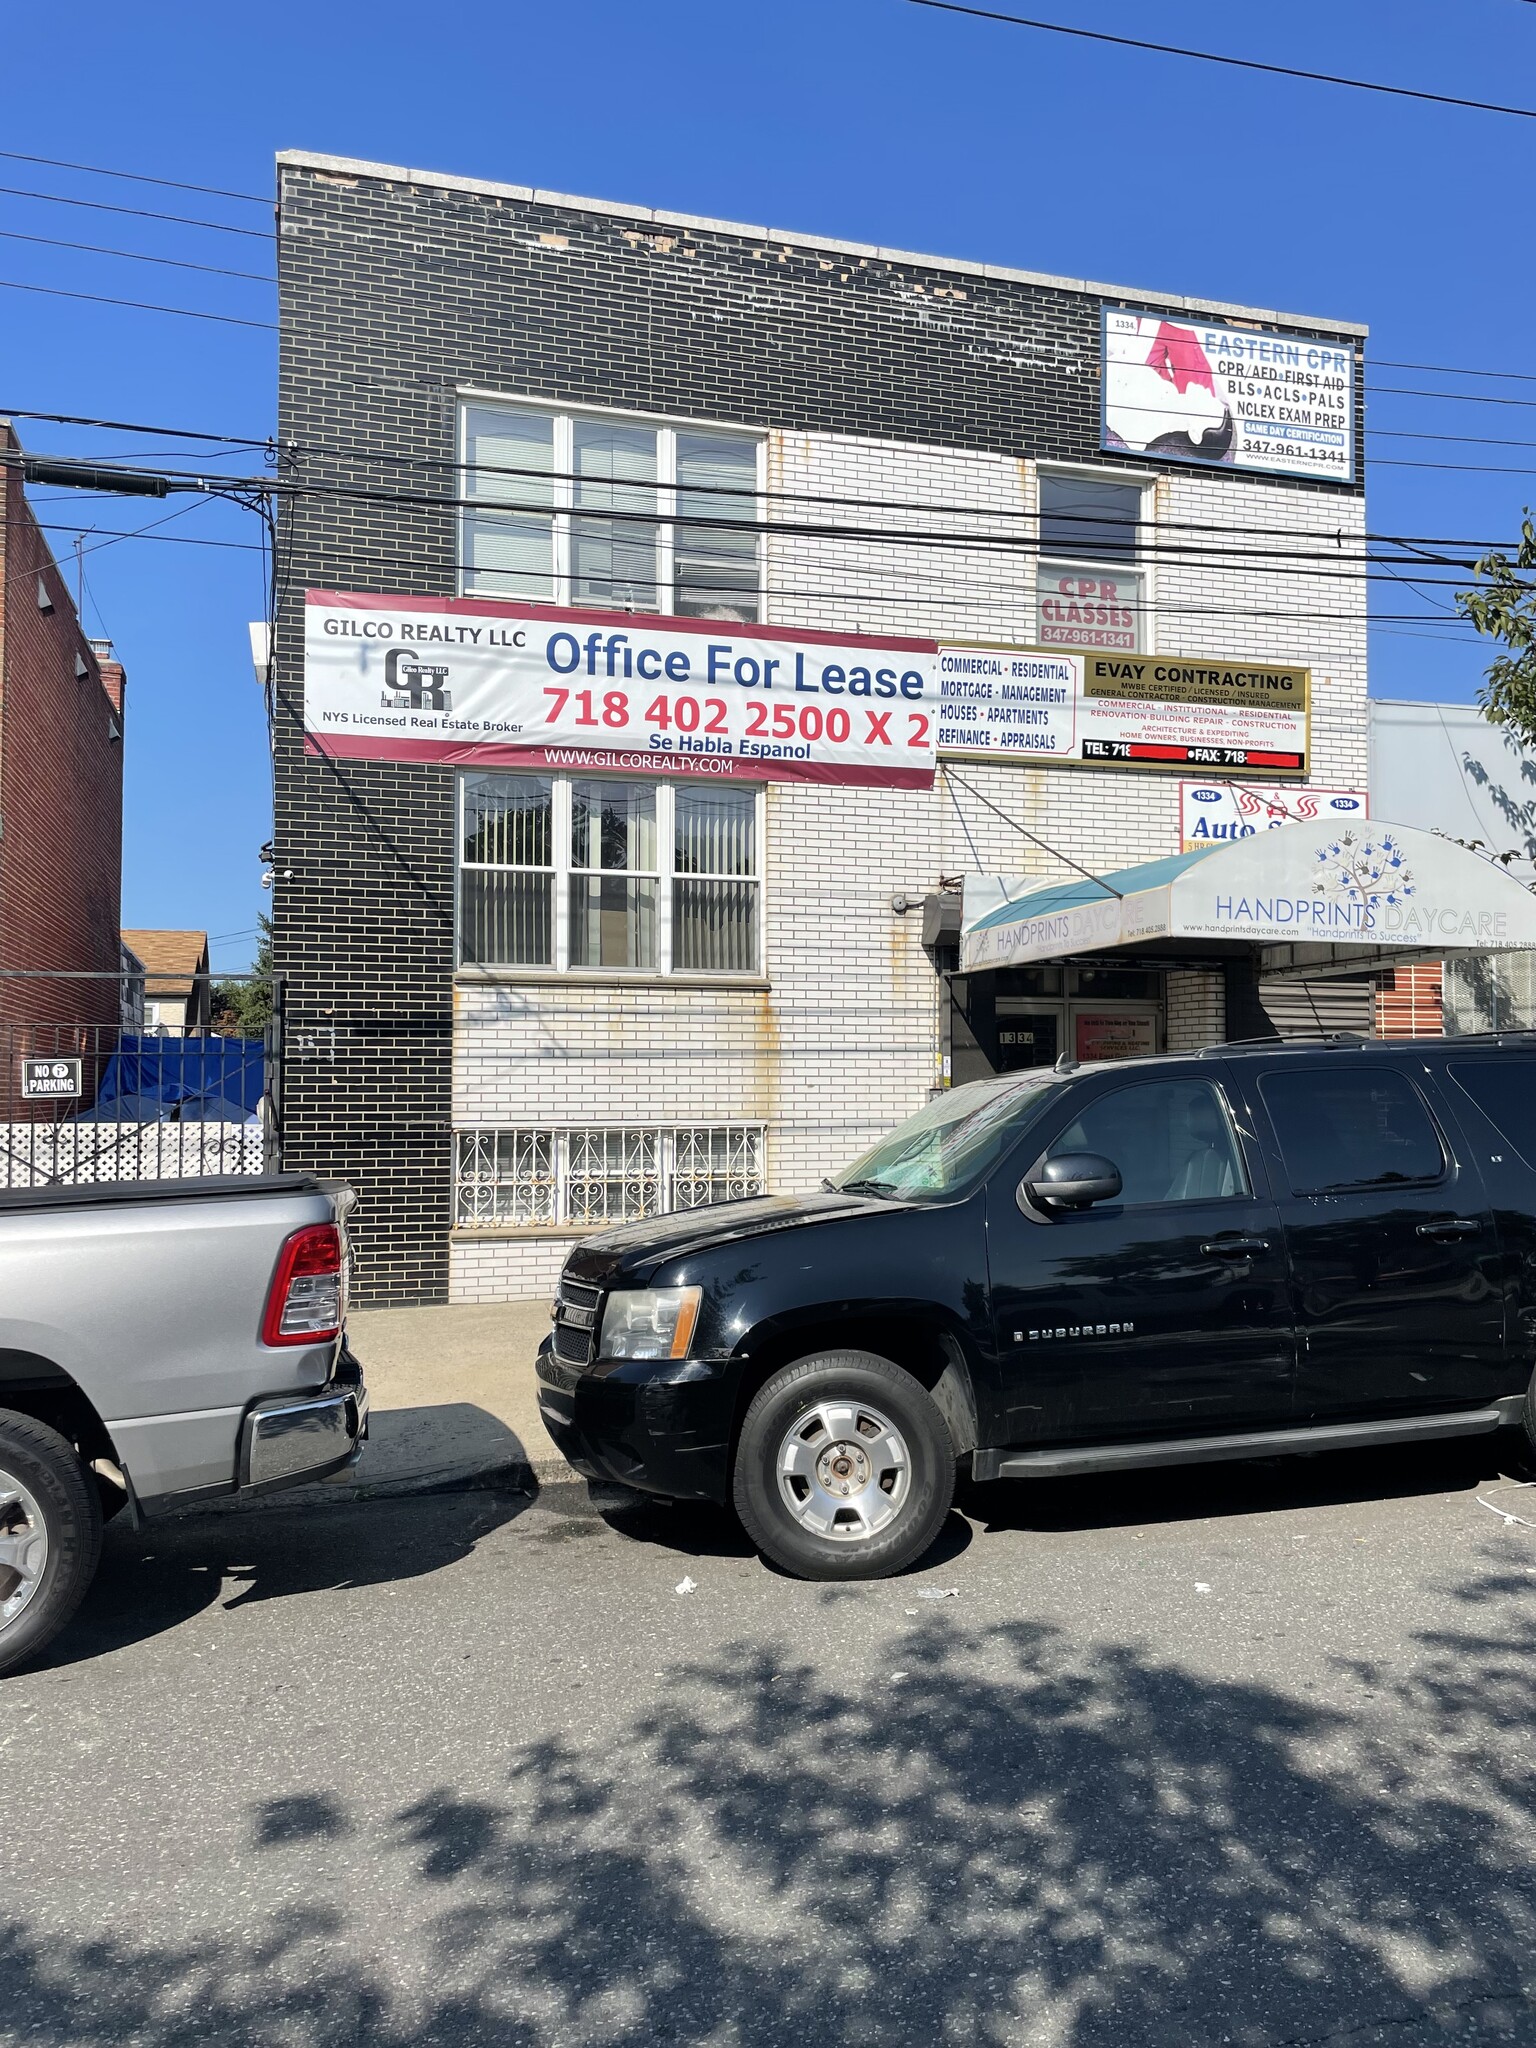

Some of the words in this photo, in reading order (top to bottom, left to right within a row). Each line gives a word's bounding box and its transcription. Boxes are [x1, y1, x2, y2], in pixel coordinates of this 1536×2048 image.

[1205, 332, 1299, 366] EASTERN
[1307, 348, 1346, 374] CPR
[1323, 376, 1344, 391] AID
[1237, 401, 1275, 419] NCLEX
[1279, 407, 1311, 424] EXAM
[1315, 412, 1345, 429] PREP
[1245, 422, 1268, 434] SAME
[1269, 426, 1285, 437] DAY
[1286, 428, 1342, 445] CERTIFICATION
[1242, 439, 1346, 463] 347-961-1341
[1246, 453, 1344, 471] WWW.EASTERNCPR.COM
[1058, 576, 1118, 602] CPR
[1042, 599, 1133, 628] CLASSES
[323, 618, 393, 639] GILCO
[400, 623, 482, 645] REALTY
[489, 629, 526, 647] LLC
[1044, 627, 1131, 647] 347-961-1341
[545, 631, 691, 682] Office
[707, 644, 780, 689] For
[795, 652, 924, 700] Lease
[941, 656, 1002, 676] COMMERCIAL
[1011, 662, 1069, 680] RESIDENTIAL
[1095, 662, 1146, 680] EVAY
[1154, 666, 1293, 690] CONTRACTING
[940, 680, 993, 699] MORTGAGE
[1001, 684, 1067, 703] MANAGEMENT
[1090, 688, 1126, 698] GENERAL
[1127, 691, 1180, 701] CONTRACTOR
[1187, 695, 1246, 706] CONSTRUCTION
[1248, 700, 1302, 709] MANAGEMENT
[1120, 682, 1146, 690] MWBE
[1148, 684, 1187, 694] CERTIFIED
[1194, 687, 1230, 697] LICENSED
[1237, 691, 1270, 699] INSURED
[543, 687, 629, 728] 718
[645, 694, 729, 735] 402
[745, 701, 851, 743] 2500
[864, 710, 894, 746] X
[907, 713, 931, 748] 2
[940, 704, 977, 721] HOUSES
[987, 707, 1049, 725] APARTMENTS
[1098, 700, 1156, 710] COMMERCIAL
[1164, 705, 1228, 715] INSTITUTIONAL
[1239, 710, 1292, 720] RESIDENTIAL
[322, 711, 349, 723] NYS
[352, 713, 406, 727] Licensed
[411, 716, 437, 729] Real
[442, 718, 479, 731] Estate
[484, 720, 523, 733] Broker
[1141, 725, 1197, 734] ARCHITECTURE
[1206, 729, 1249, 737] EXPEDITING
[1193, 717, 1223, 725] REPAIR
[1231, 720, 1297, 730] CONSTRUCTION
[649, 733, 673, 751] Se
[679, 735, 732, 755] Habla
[740, 739, 811, 759] Espanol
[939, 728, 991, 745] REFINANCE
[1000, 732, 1056, 750] APPRAISALS
[1120, 731, 1142, 739] HOME
[1144, 733, 1179, 742] OWNERS,
[1227, 738, 1274, 748] NON-PROFITS
[544, 749, 733, 774] WWW.GILCOREALTY.COM
[1085, 741, 1109, 756] TEL:
[1195, 748, 1221, 762] FAX:
[1196, 792, 1216, 801] 1334
[1334, 799, 1353, 809] 1334
[1191, 817, 1256, 840] Auto
[1216, 895, 1376, 928] HANDPRINTS
[1385, 904, 1507, 937] DAYCARE
[997, 915, 1069, 951] HANDPRINTS
[1183, 924, 1299, 936] www.handprintsdaycare.com
[1366, 930, 1377, 940] To
[34, 1065, 49, 1077] NO
[29, 1078, 74, 1092] PARKING
[1028, 1322, 1134, 1341] SUBURBAN
